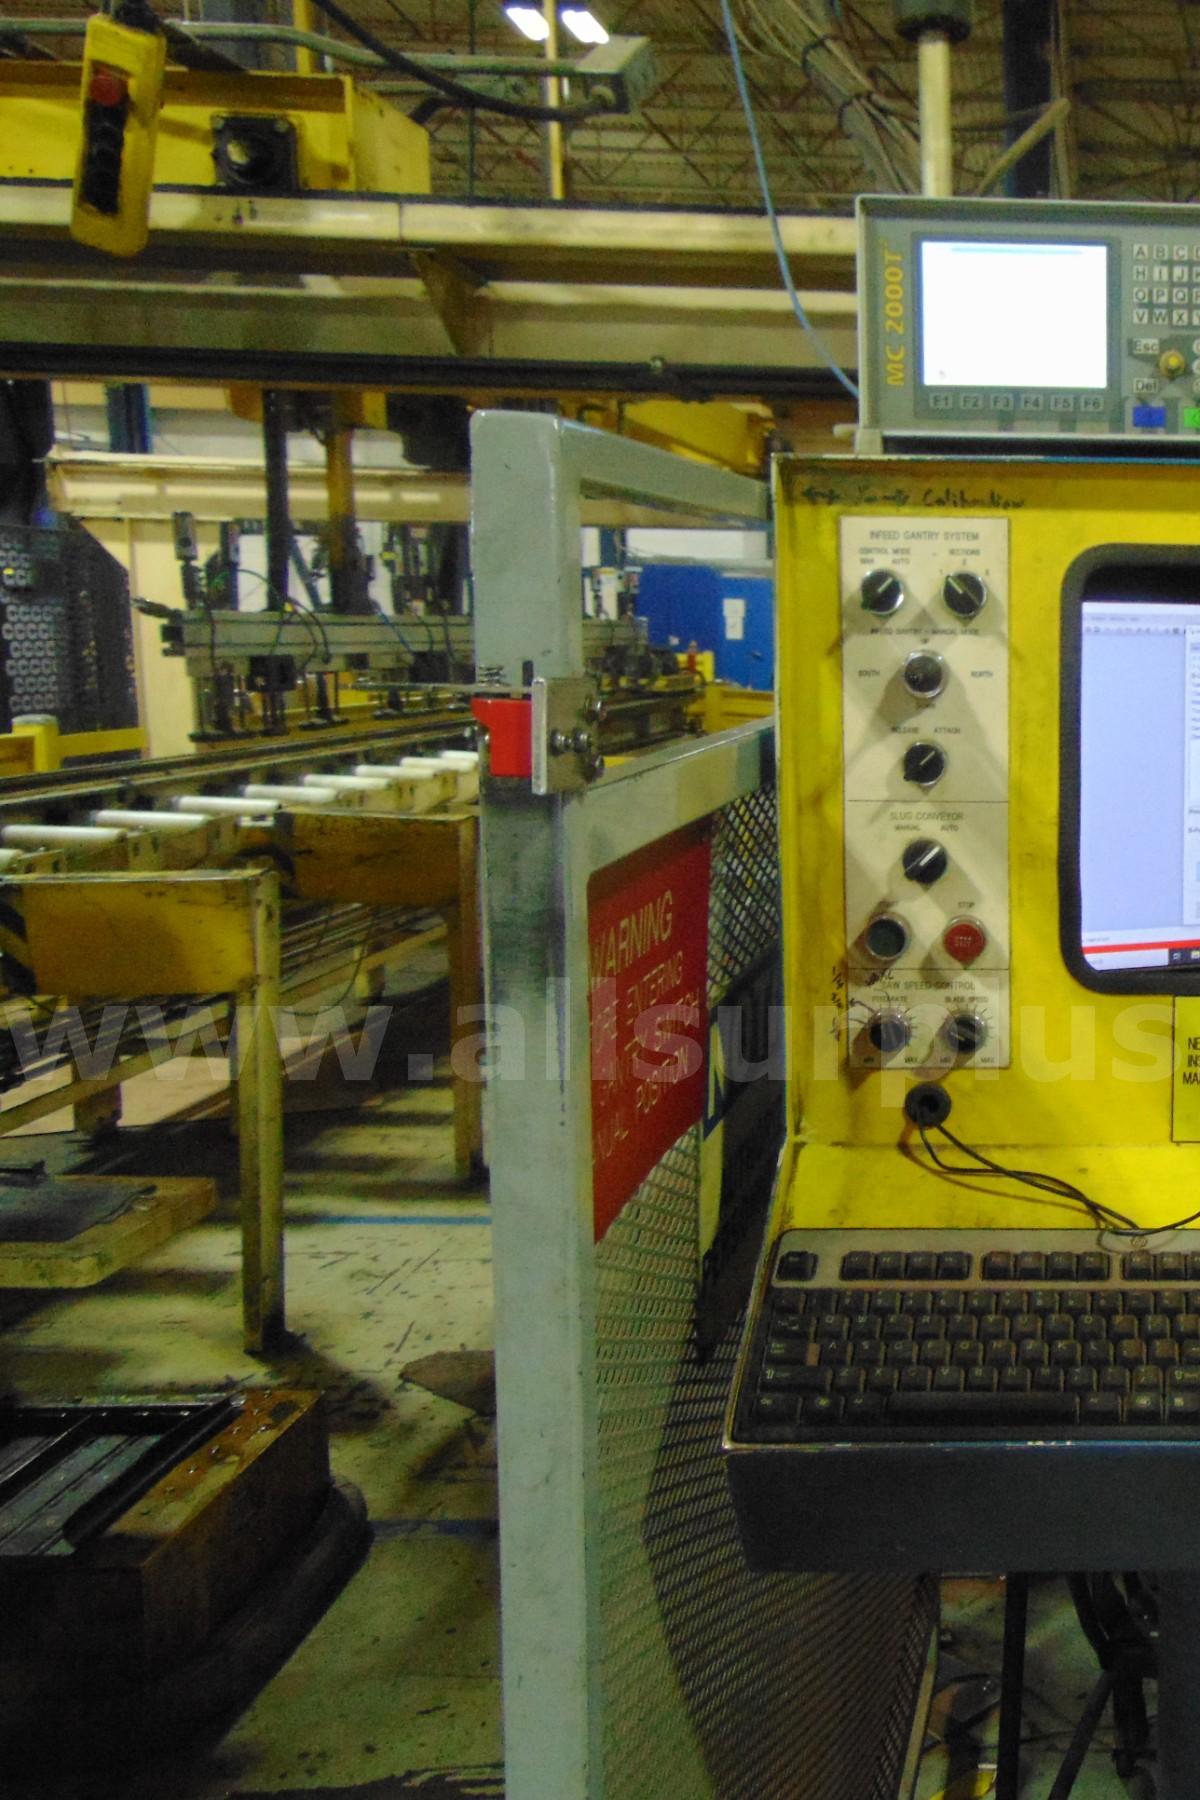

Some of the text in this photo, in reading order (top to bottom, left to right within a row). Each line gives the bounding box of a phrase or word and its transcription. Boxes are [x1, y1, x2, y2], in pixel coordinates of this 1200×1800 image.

[885, 248, 905, 386] MC 2000T
[1135, 341, 1158, 352] Esc
[1136, 380, 1157, 392] Del
[933, 394, 951, 407] F1
[963, 395, 980, 407] F2
[1023, 396, 1040, 408] F4
[1053, 396, 1071, 409] F5
[1083, 397, 1101, 409] F6
[903, 530, 939, 541] GANTRY
[943, 531, 979, 541] SYSTEM
[627, 951, 683, 1026] ENTERING
